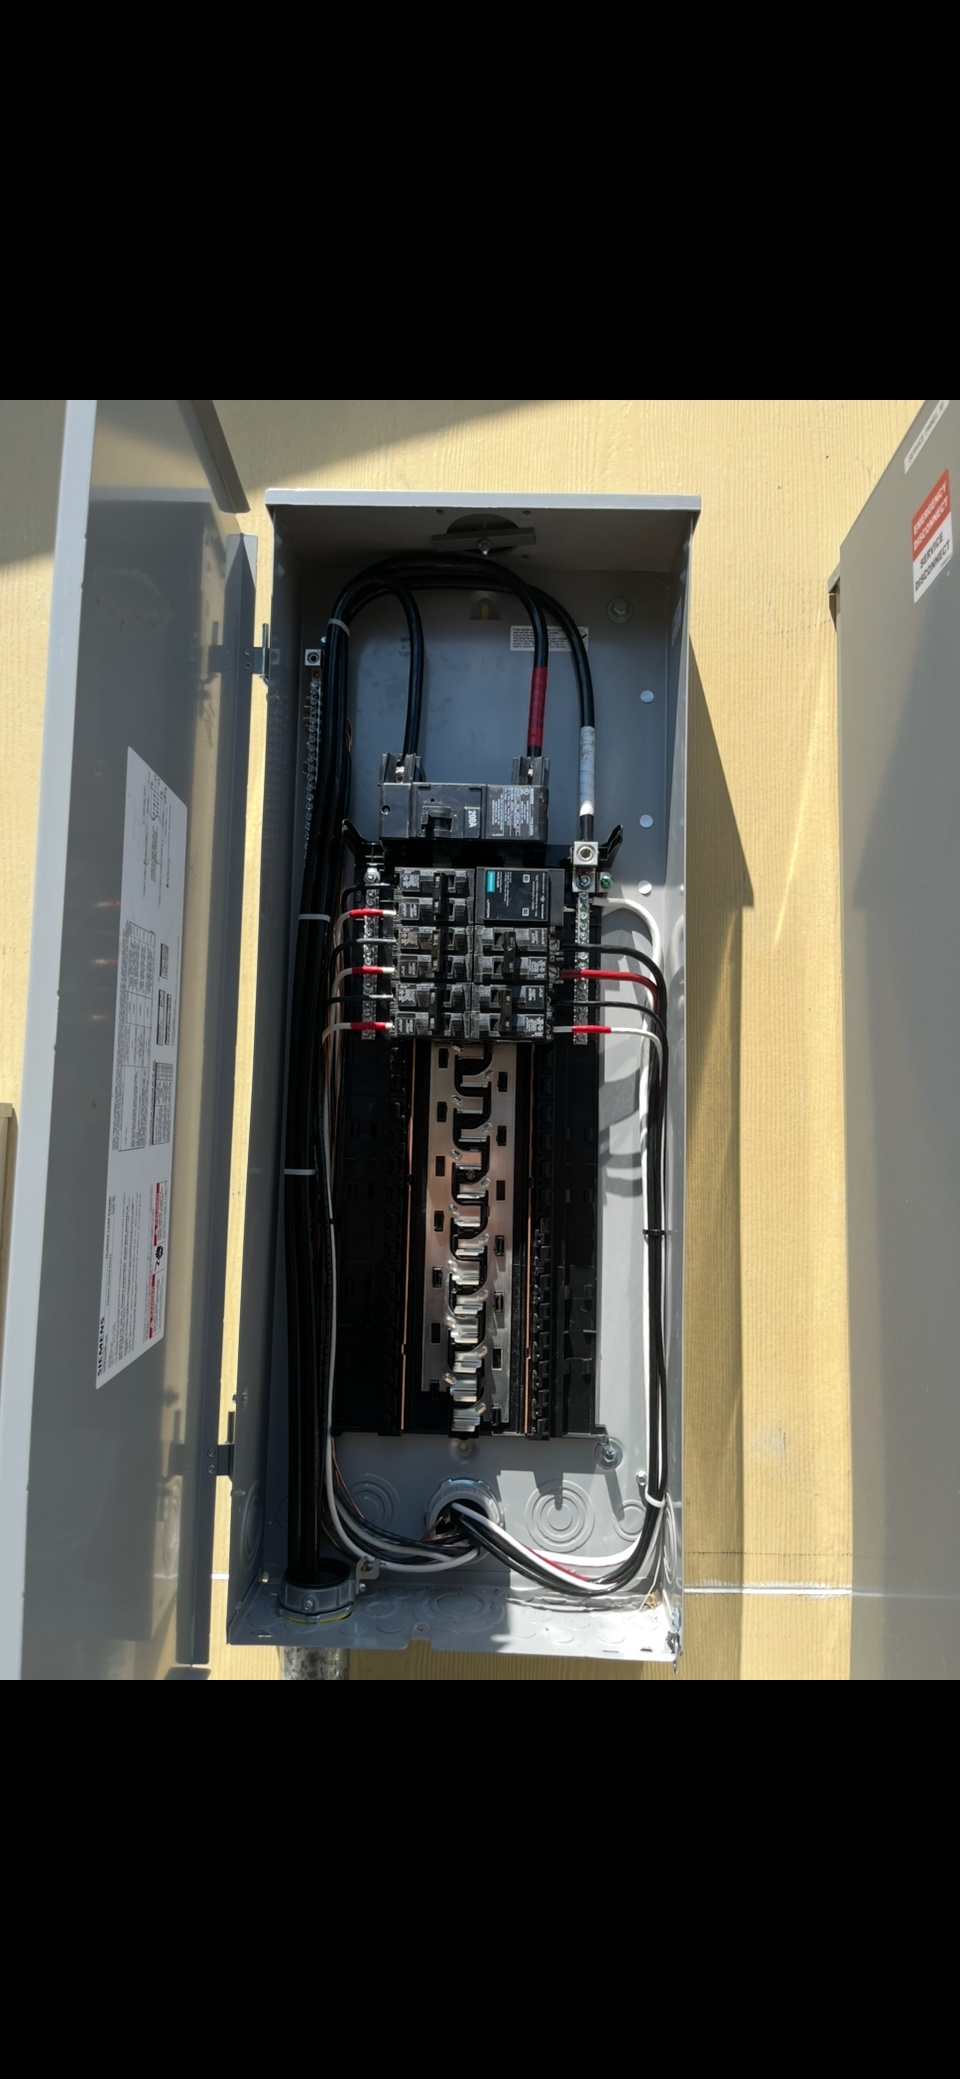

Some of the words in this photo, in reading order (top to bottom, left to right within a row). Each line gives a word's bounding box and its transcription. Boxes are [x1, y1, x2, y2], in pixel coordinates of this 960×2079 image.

[913, 481, 947, 535] EMERGENCY
[913, 496, 949, 551] DISCONNECT
[915, 539, 950, 592] DISCONNECT
[919, 531, 944, 569] SERVICE
[467, 809, 477, 828] 200A
[97, 1316, 105, 1377] SIEMENS
